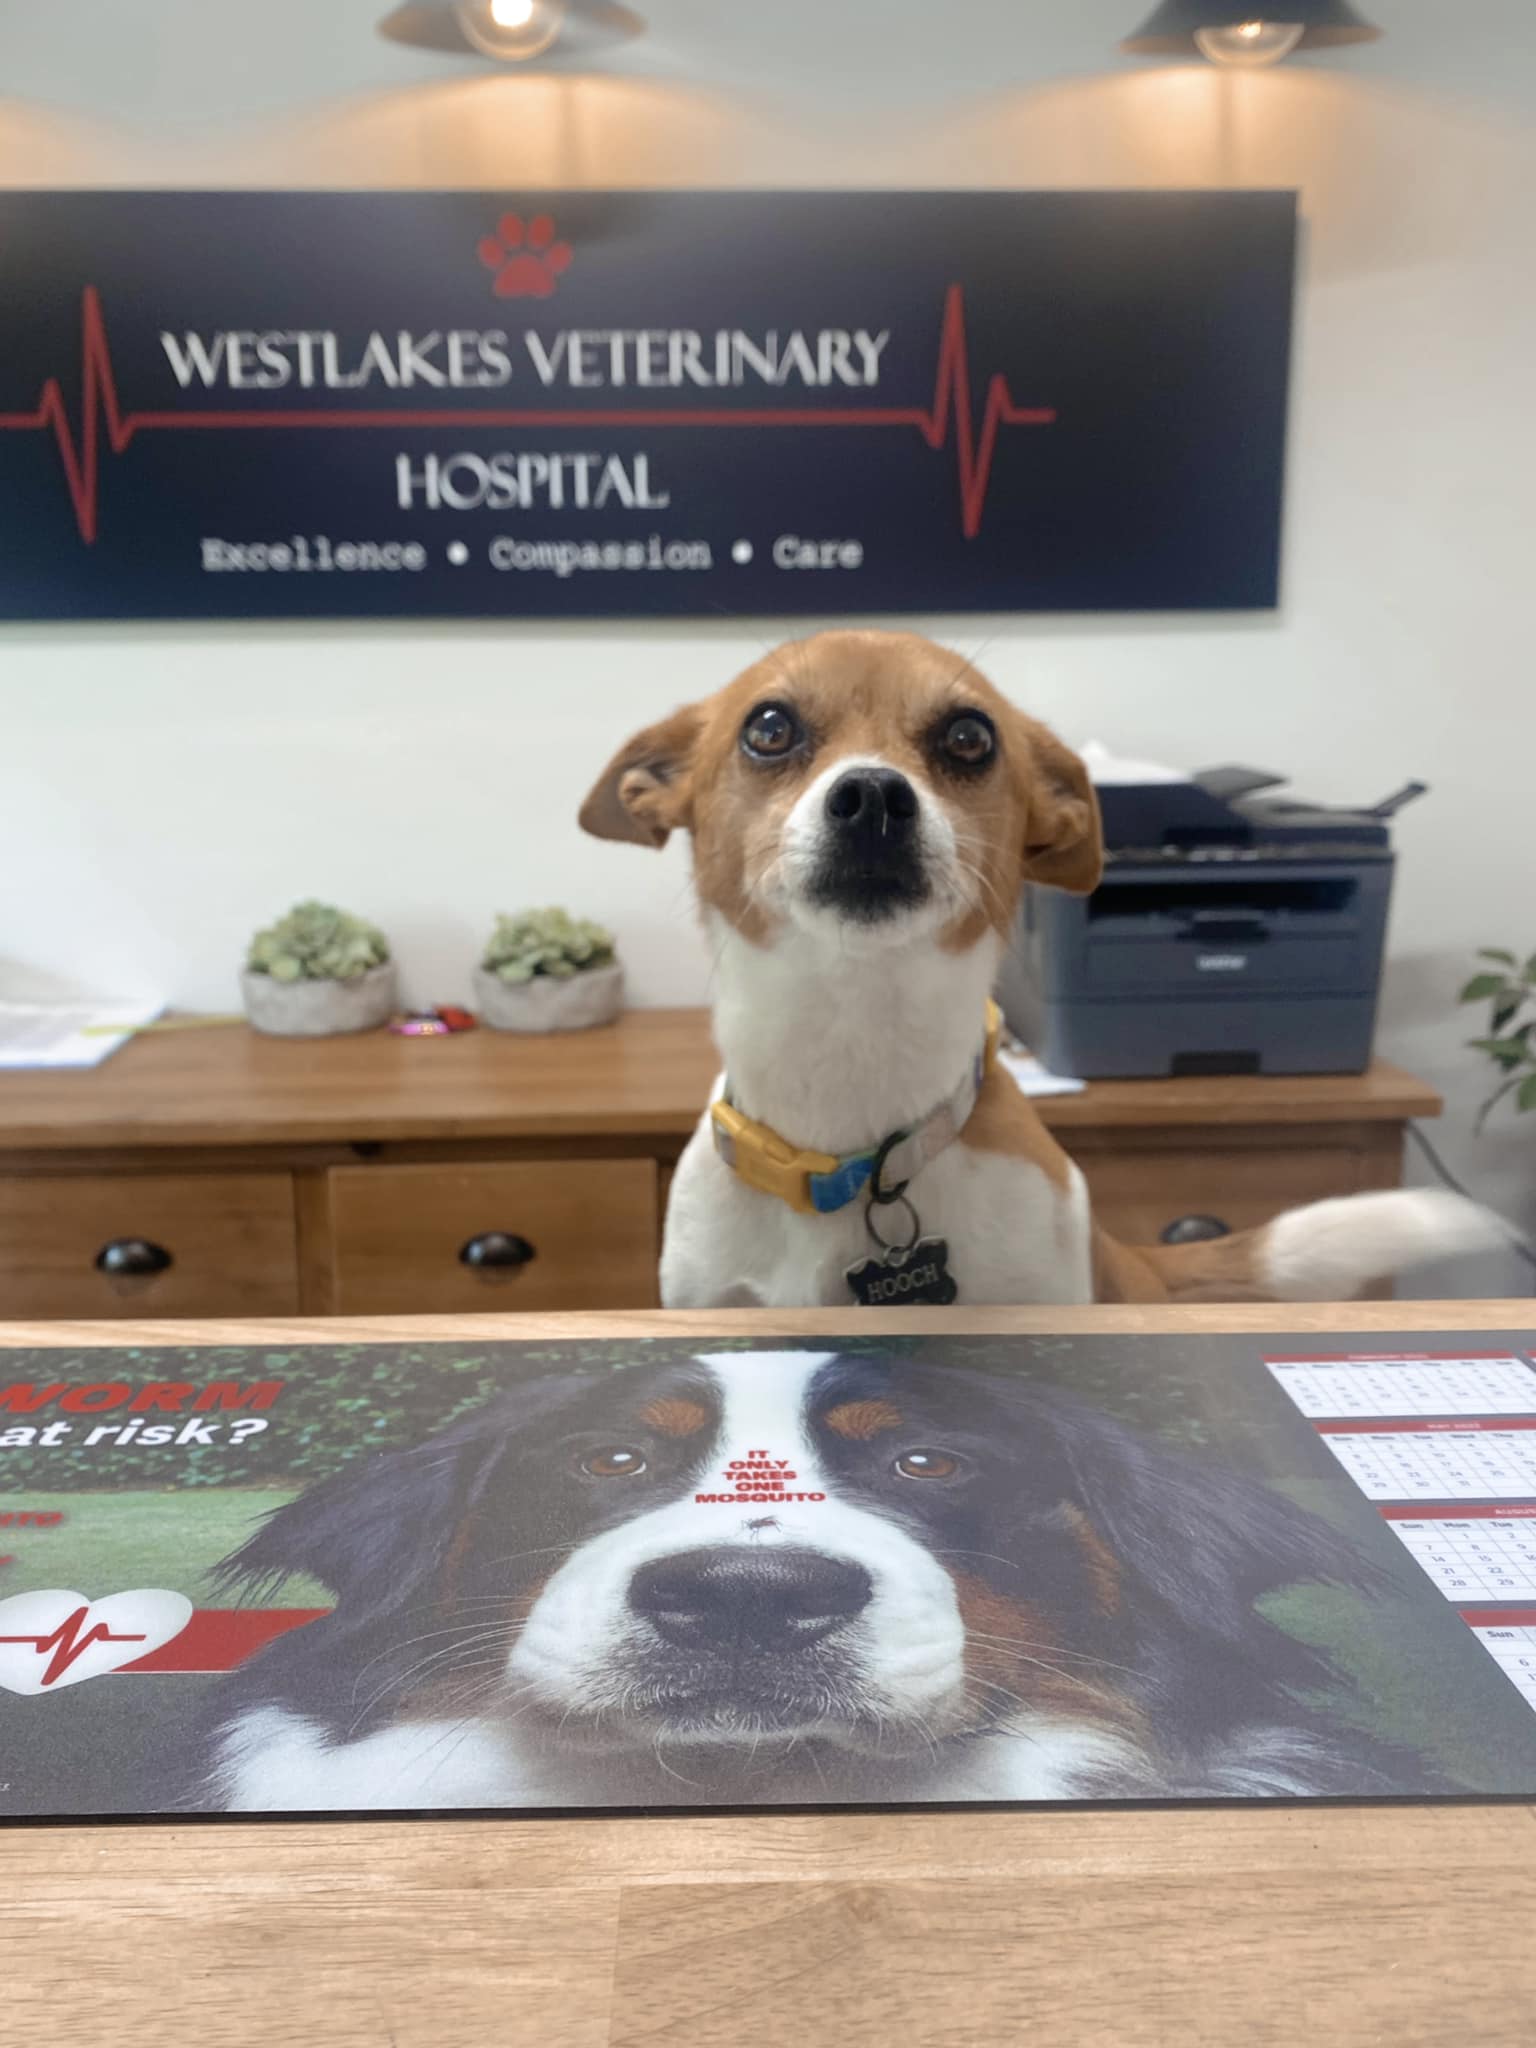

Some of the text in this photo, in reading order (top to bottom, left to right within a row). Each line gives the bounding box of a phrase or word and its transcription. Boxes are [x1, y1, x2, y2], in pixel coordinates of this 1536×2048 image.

[160, 329, 890, 389] WESTLAKES VETERINARY
[395, 451, 671, 510] HOSPITAL
[201, 533, 864, 578] Excellence Compassion Care
[867, 1263, 939, 1302] HOOCH
[0, 1418, 269, 1447] at risk?
[748, 1450, 769, 1459] IT
[728, 1460, 789, 1470] ONLY
[721, 1471, 797, 1481] TAKES
[734, 1482, 785, 1492] ONE
[695, 1492, 826, 1504] MOSQUITO
[1519, 1658, 1530, 1667] 6
